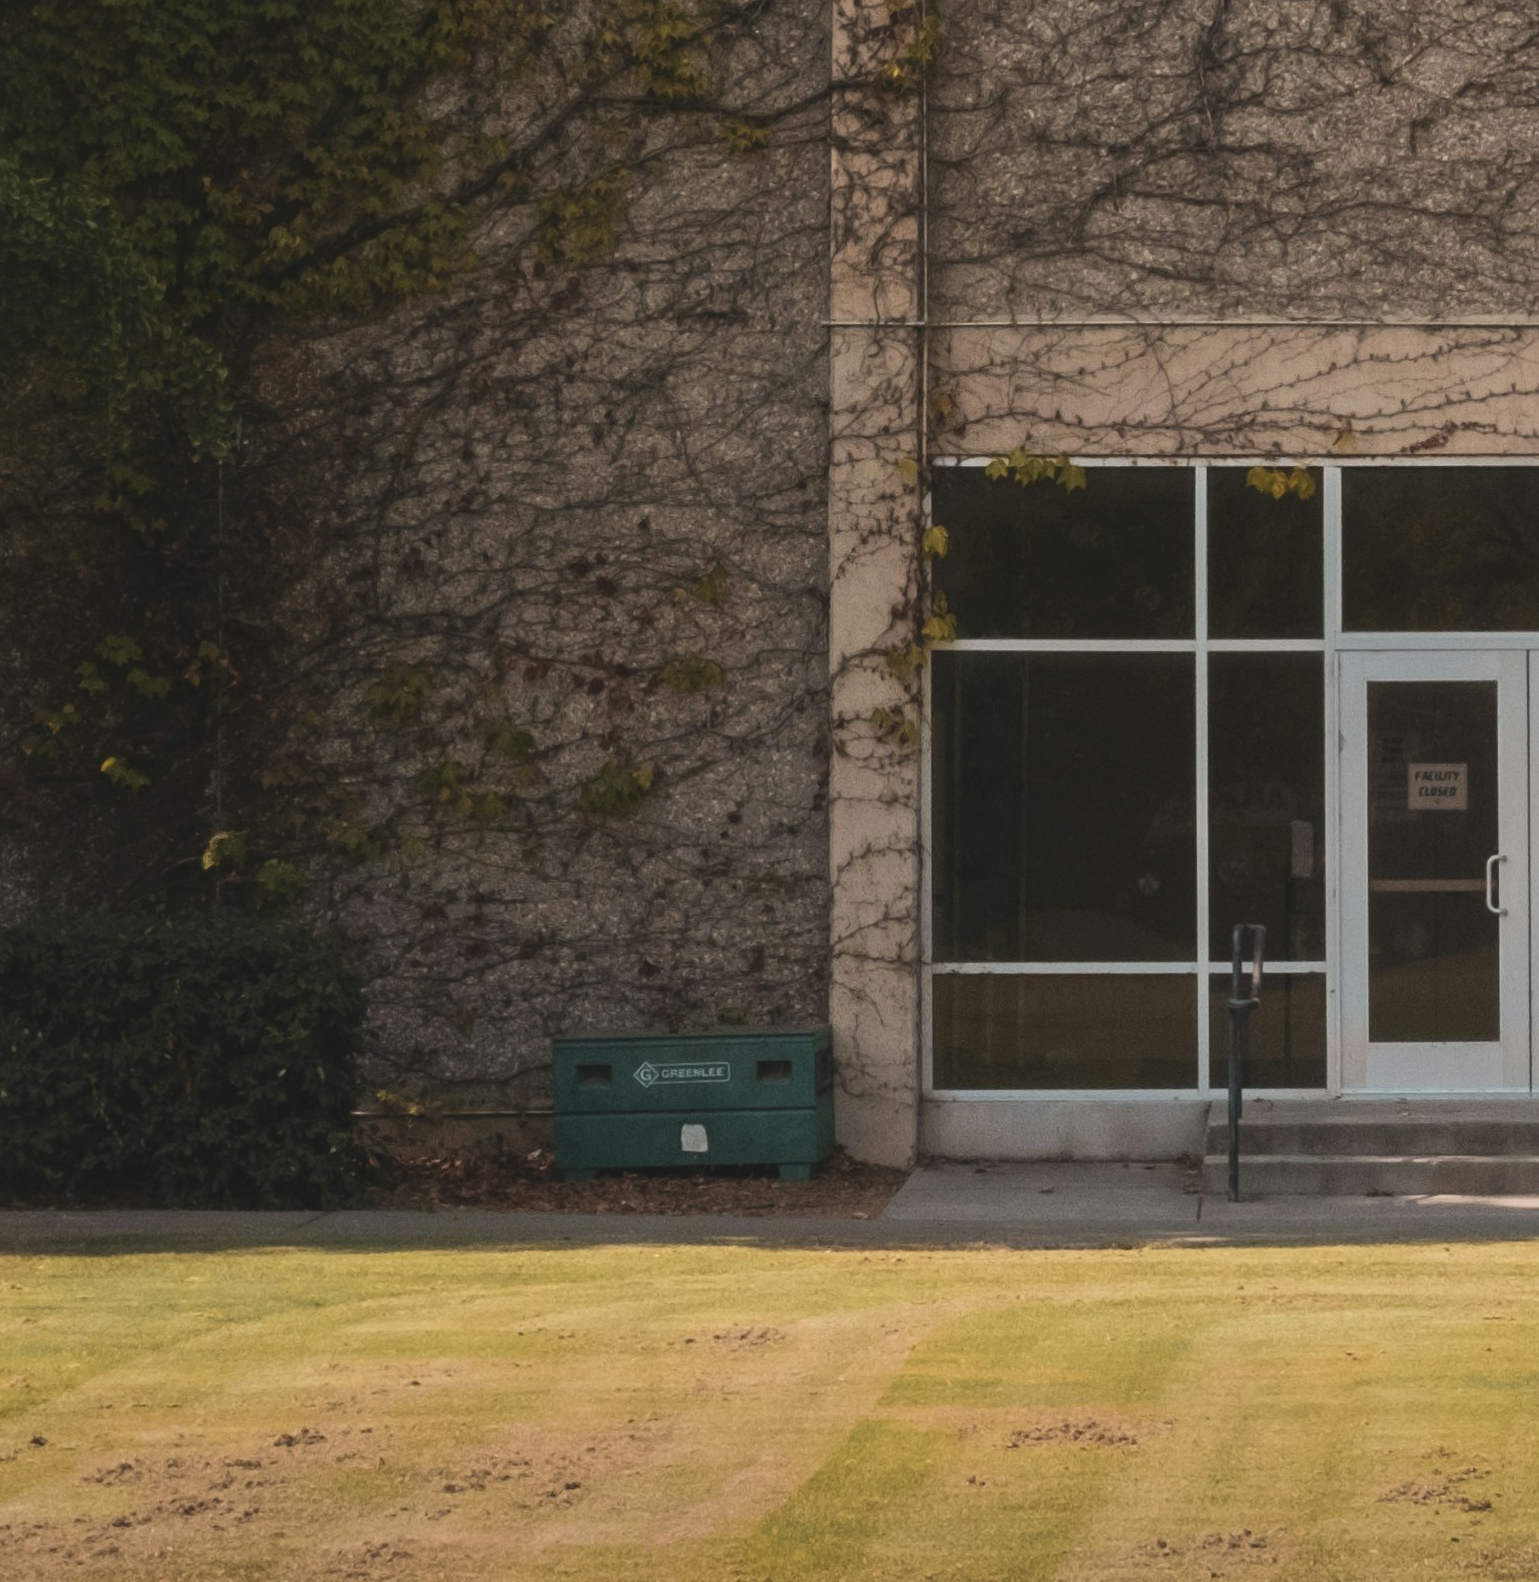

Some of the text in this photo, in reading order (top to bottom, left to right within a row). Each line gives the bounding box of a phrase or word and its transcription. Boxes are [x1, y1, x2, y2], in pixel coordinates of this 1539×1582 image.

[1414, 770, 1460, 782] FACILITY
[1419, 786, 1457, 797] CLOSED
[661, 1067, 725, 1078] GREENLEE
